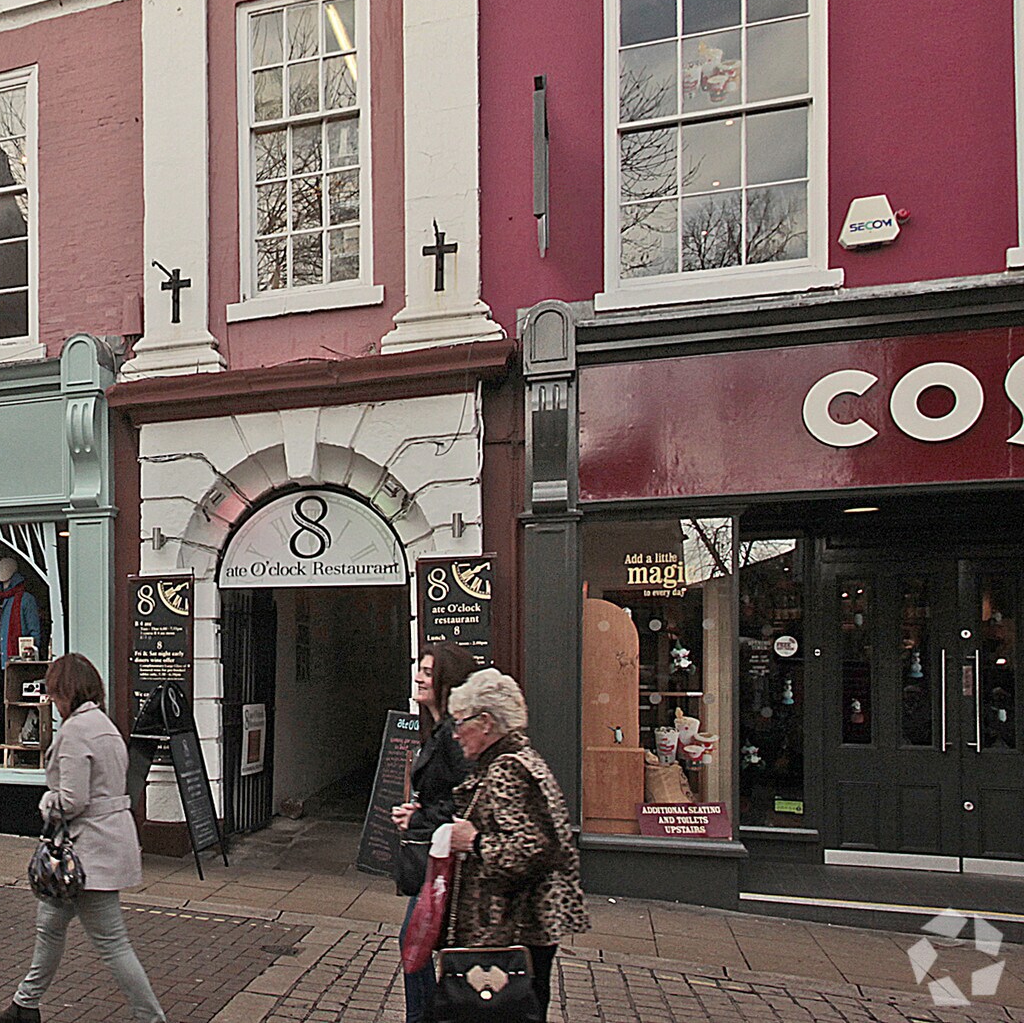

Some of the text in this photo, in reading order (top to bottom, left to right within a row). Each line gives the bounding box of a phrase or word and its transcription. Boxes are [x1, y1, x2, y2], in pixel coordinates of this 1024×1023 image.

[849, 218, 892, 233] SECOM
[289, 495, 332, 559] 8
[624, 552, 678, 565] Add a little
[226, 560, 399, 577] ate O'clock Restaurant
[428, 568, 449, 601] 8
[643, 588, 686, 598] to every day
[137, 584, 156, 615] 8
[432, 603, 481, 614] ate O'clock
[434, 615, 480, 625] restaurant
[453, 625, 461, 636] 8
[426, 634, 446, 642] Lunch
[156, 640, 163, 650] 8
[168, 688, 180, 717] 8
[641, 805, 721, 814] ADDITIONAL SEATING
[658, 816, 709, 824] AND TOILETS
[664, 825, 706, 834] UPSTAIRS
